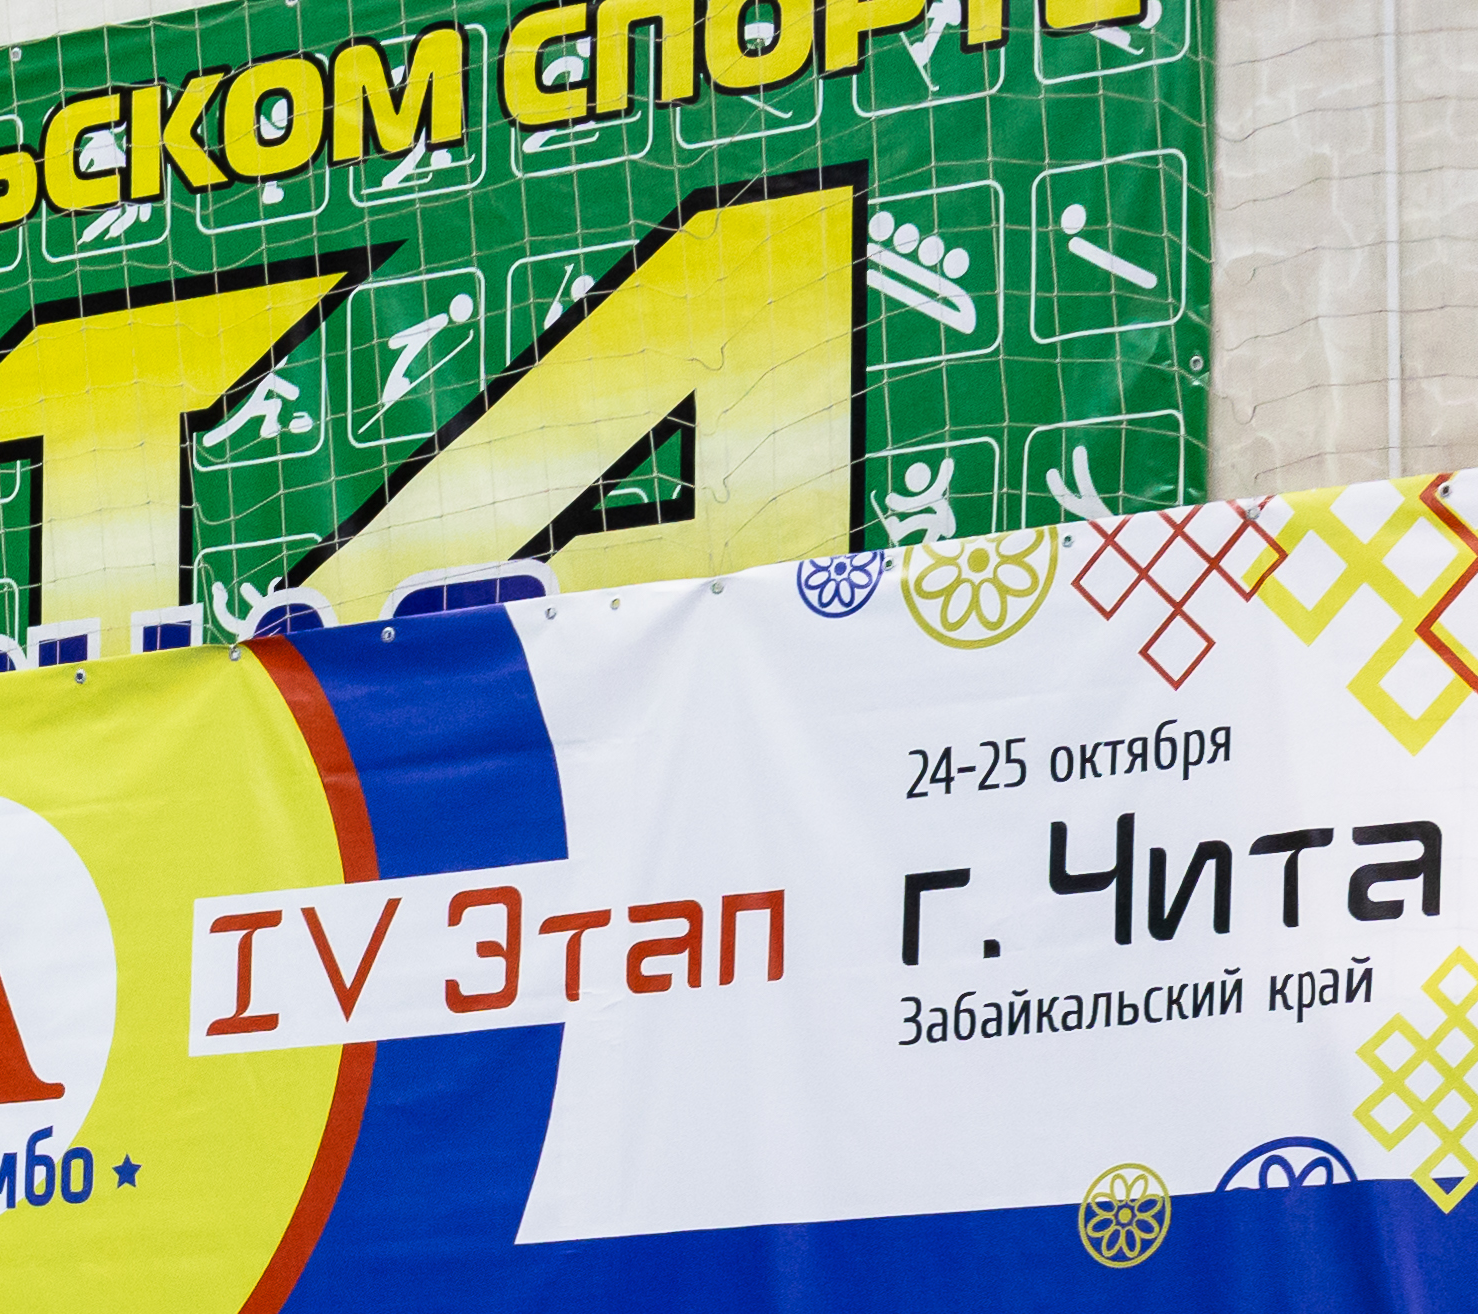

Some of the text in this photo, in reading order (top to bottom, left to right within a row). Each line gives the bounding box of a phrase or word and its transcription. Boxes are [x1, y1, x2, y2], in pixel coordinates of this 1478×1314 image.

[501, 0, 1152, 131] СПОР
[905, 719, 1232, 799] 24-25 октября
[902, 812, 1442, 966] г. Чита
[205, 885, 785, 1037] IV Этап
[898, 956, 1373, 1046] Забайкальский край
